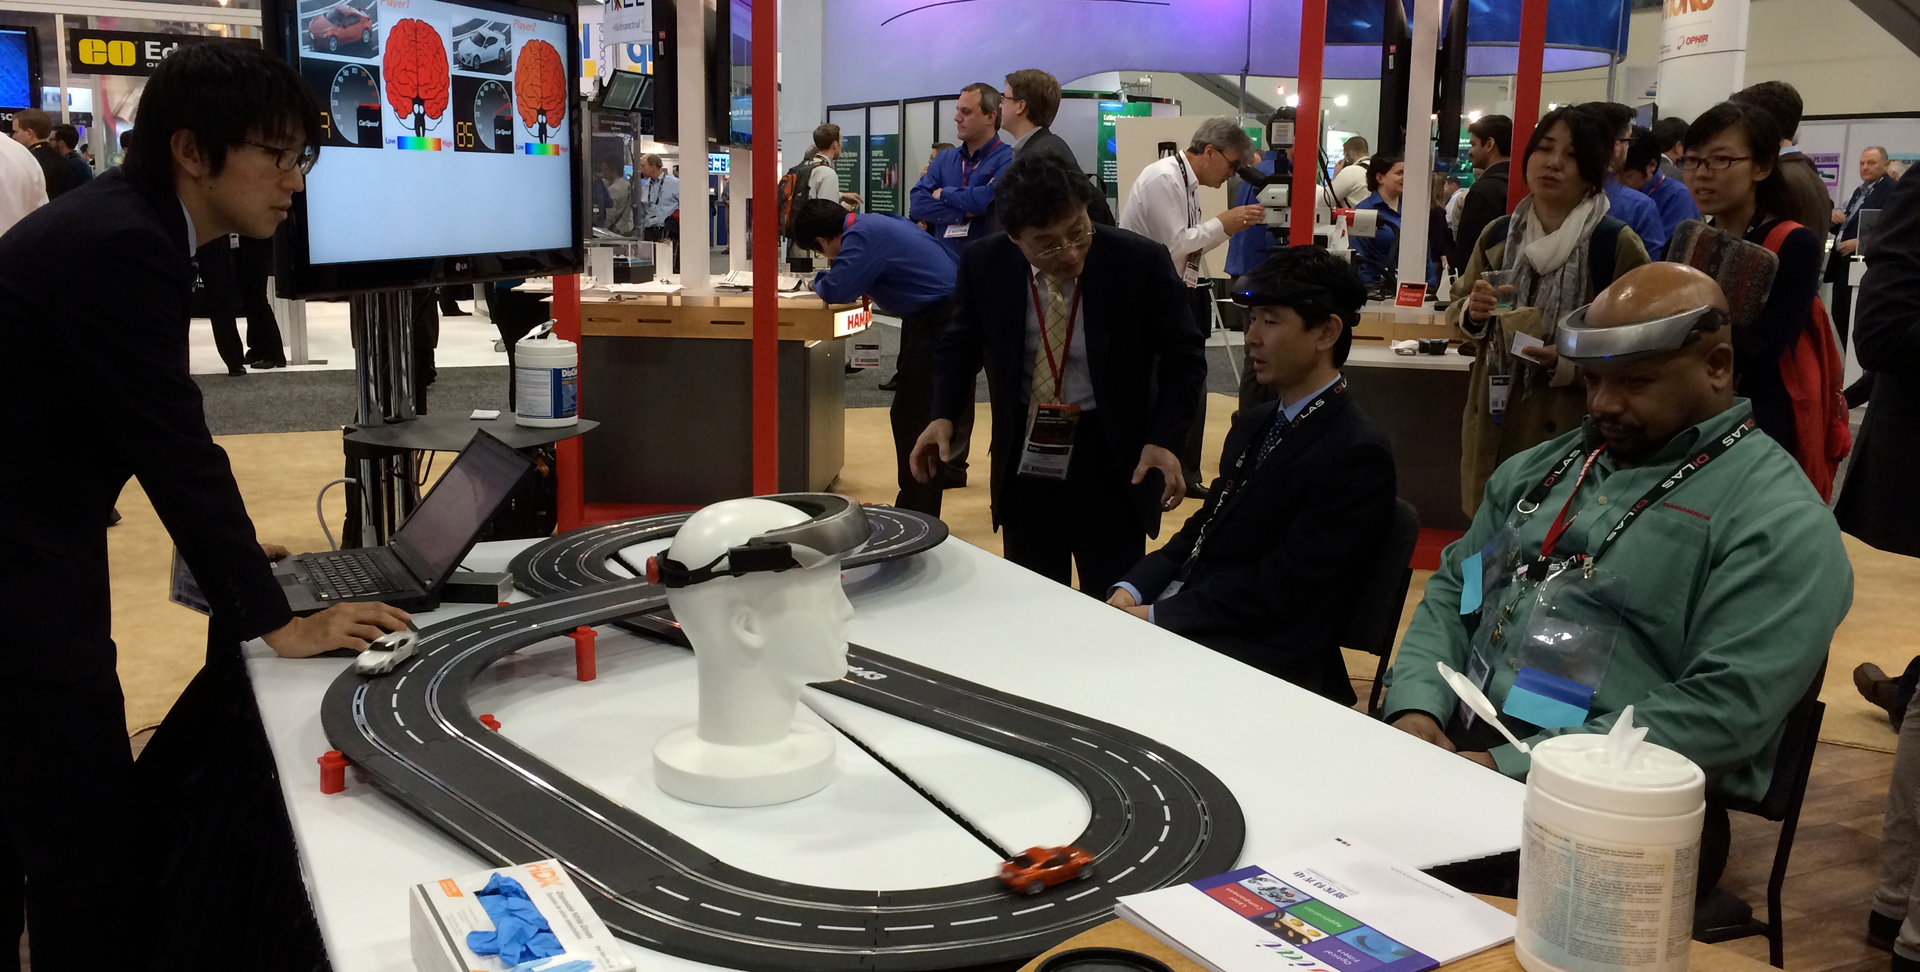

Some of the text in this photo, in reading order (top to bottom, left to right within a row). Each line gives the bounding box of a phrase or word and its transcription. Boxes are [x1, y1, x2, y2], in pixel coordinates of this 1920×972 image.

[513, 19, 537, 32] Player2
[1685, 34, 1709, 46] OPHIR
[385, 137, 396, 146] Low
[441, 140, 453, 149] High
[456, 121, 475, 148] 85
[1721, 418, 1756, 447] DILAS
[1543, 449, 1581, 488] DILAS
[1661, 453, 1710, 489] DILAS
[1606, 499, 1649, 542] DILAS
[524, 861, 565, 889] HDX
[1225, 887, 1264, 911] Component
[1228, 896, 1247, 908] Laser
[1303, 905, 1343, 928] Application
[579, 924, 594, 939] Gloves
[1323, 949, 1352, 966] Optical
